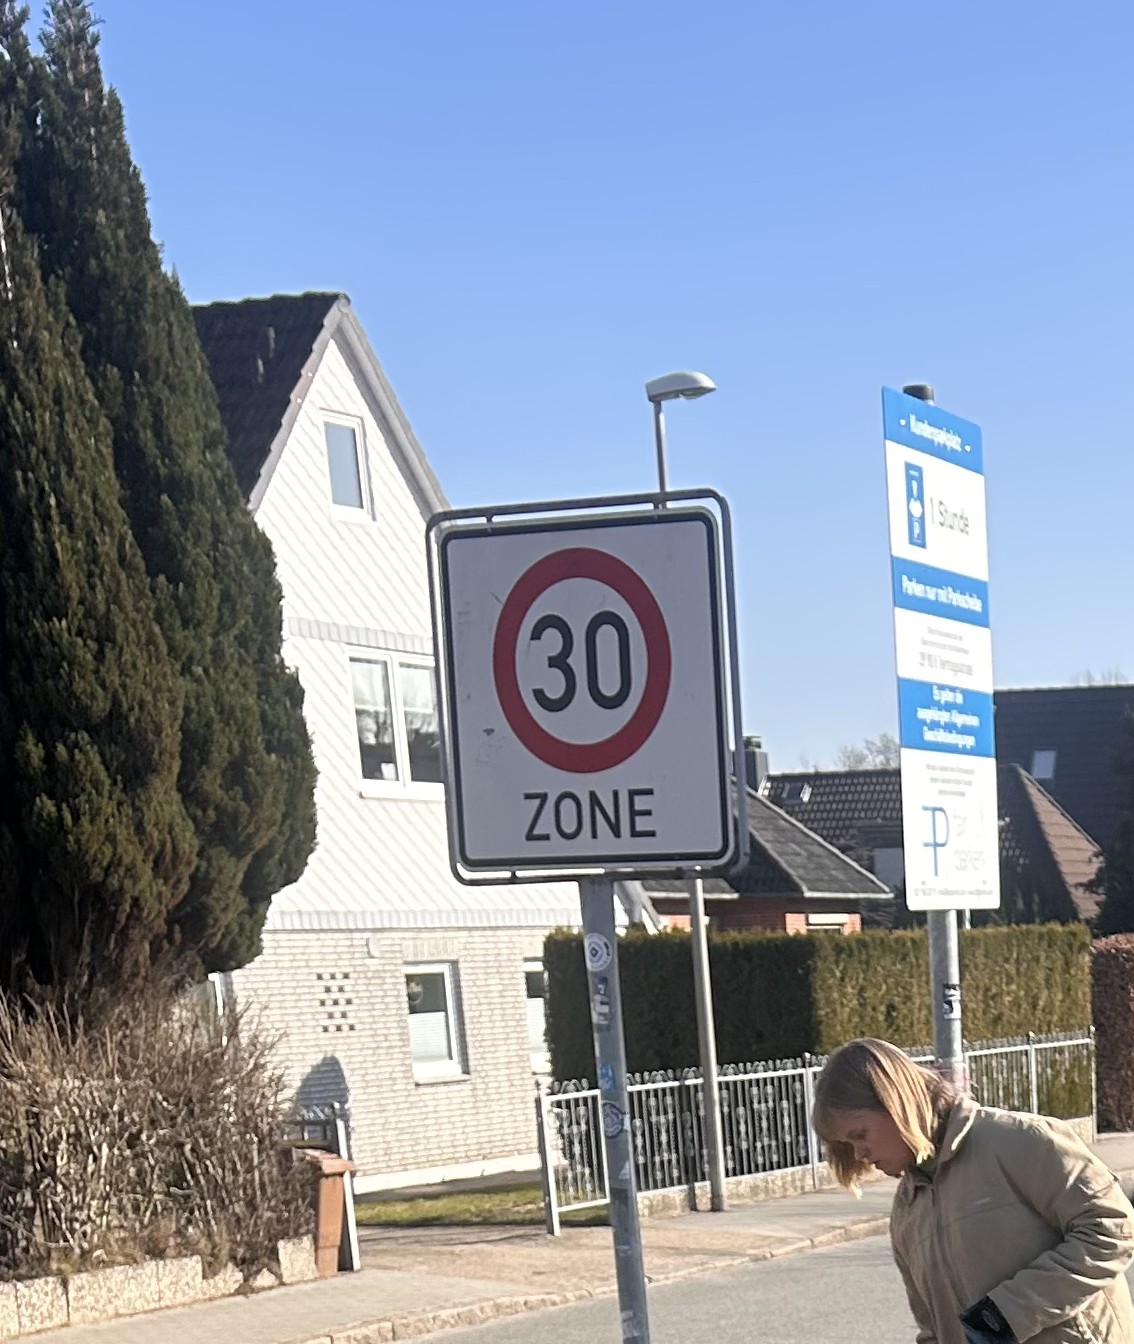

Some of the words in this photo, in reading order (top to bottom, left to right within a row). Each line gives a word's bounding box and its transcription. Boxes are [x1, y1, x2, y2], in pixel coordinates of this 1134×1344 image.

[938, 499, 970, 535] Stunde
[530, 610, 632, 712] 30
[524, 787, 657, 842] ZONE
